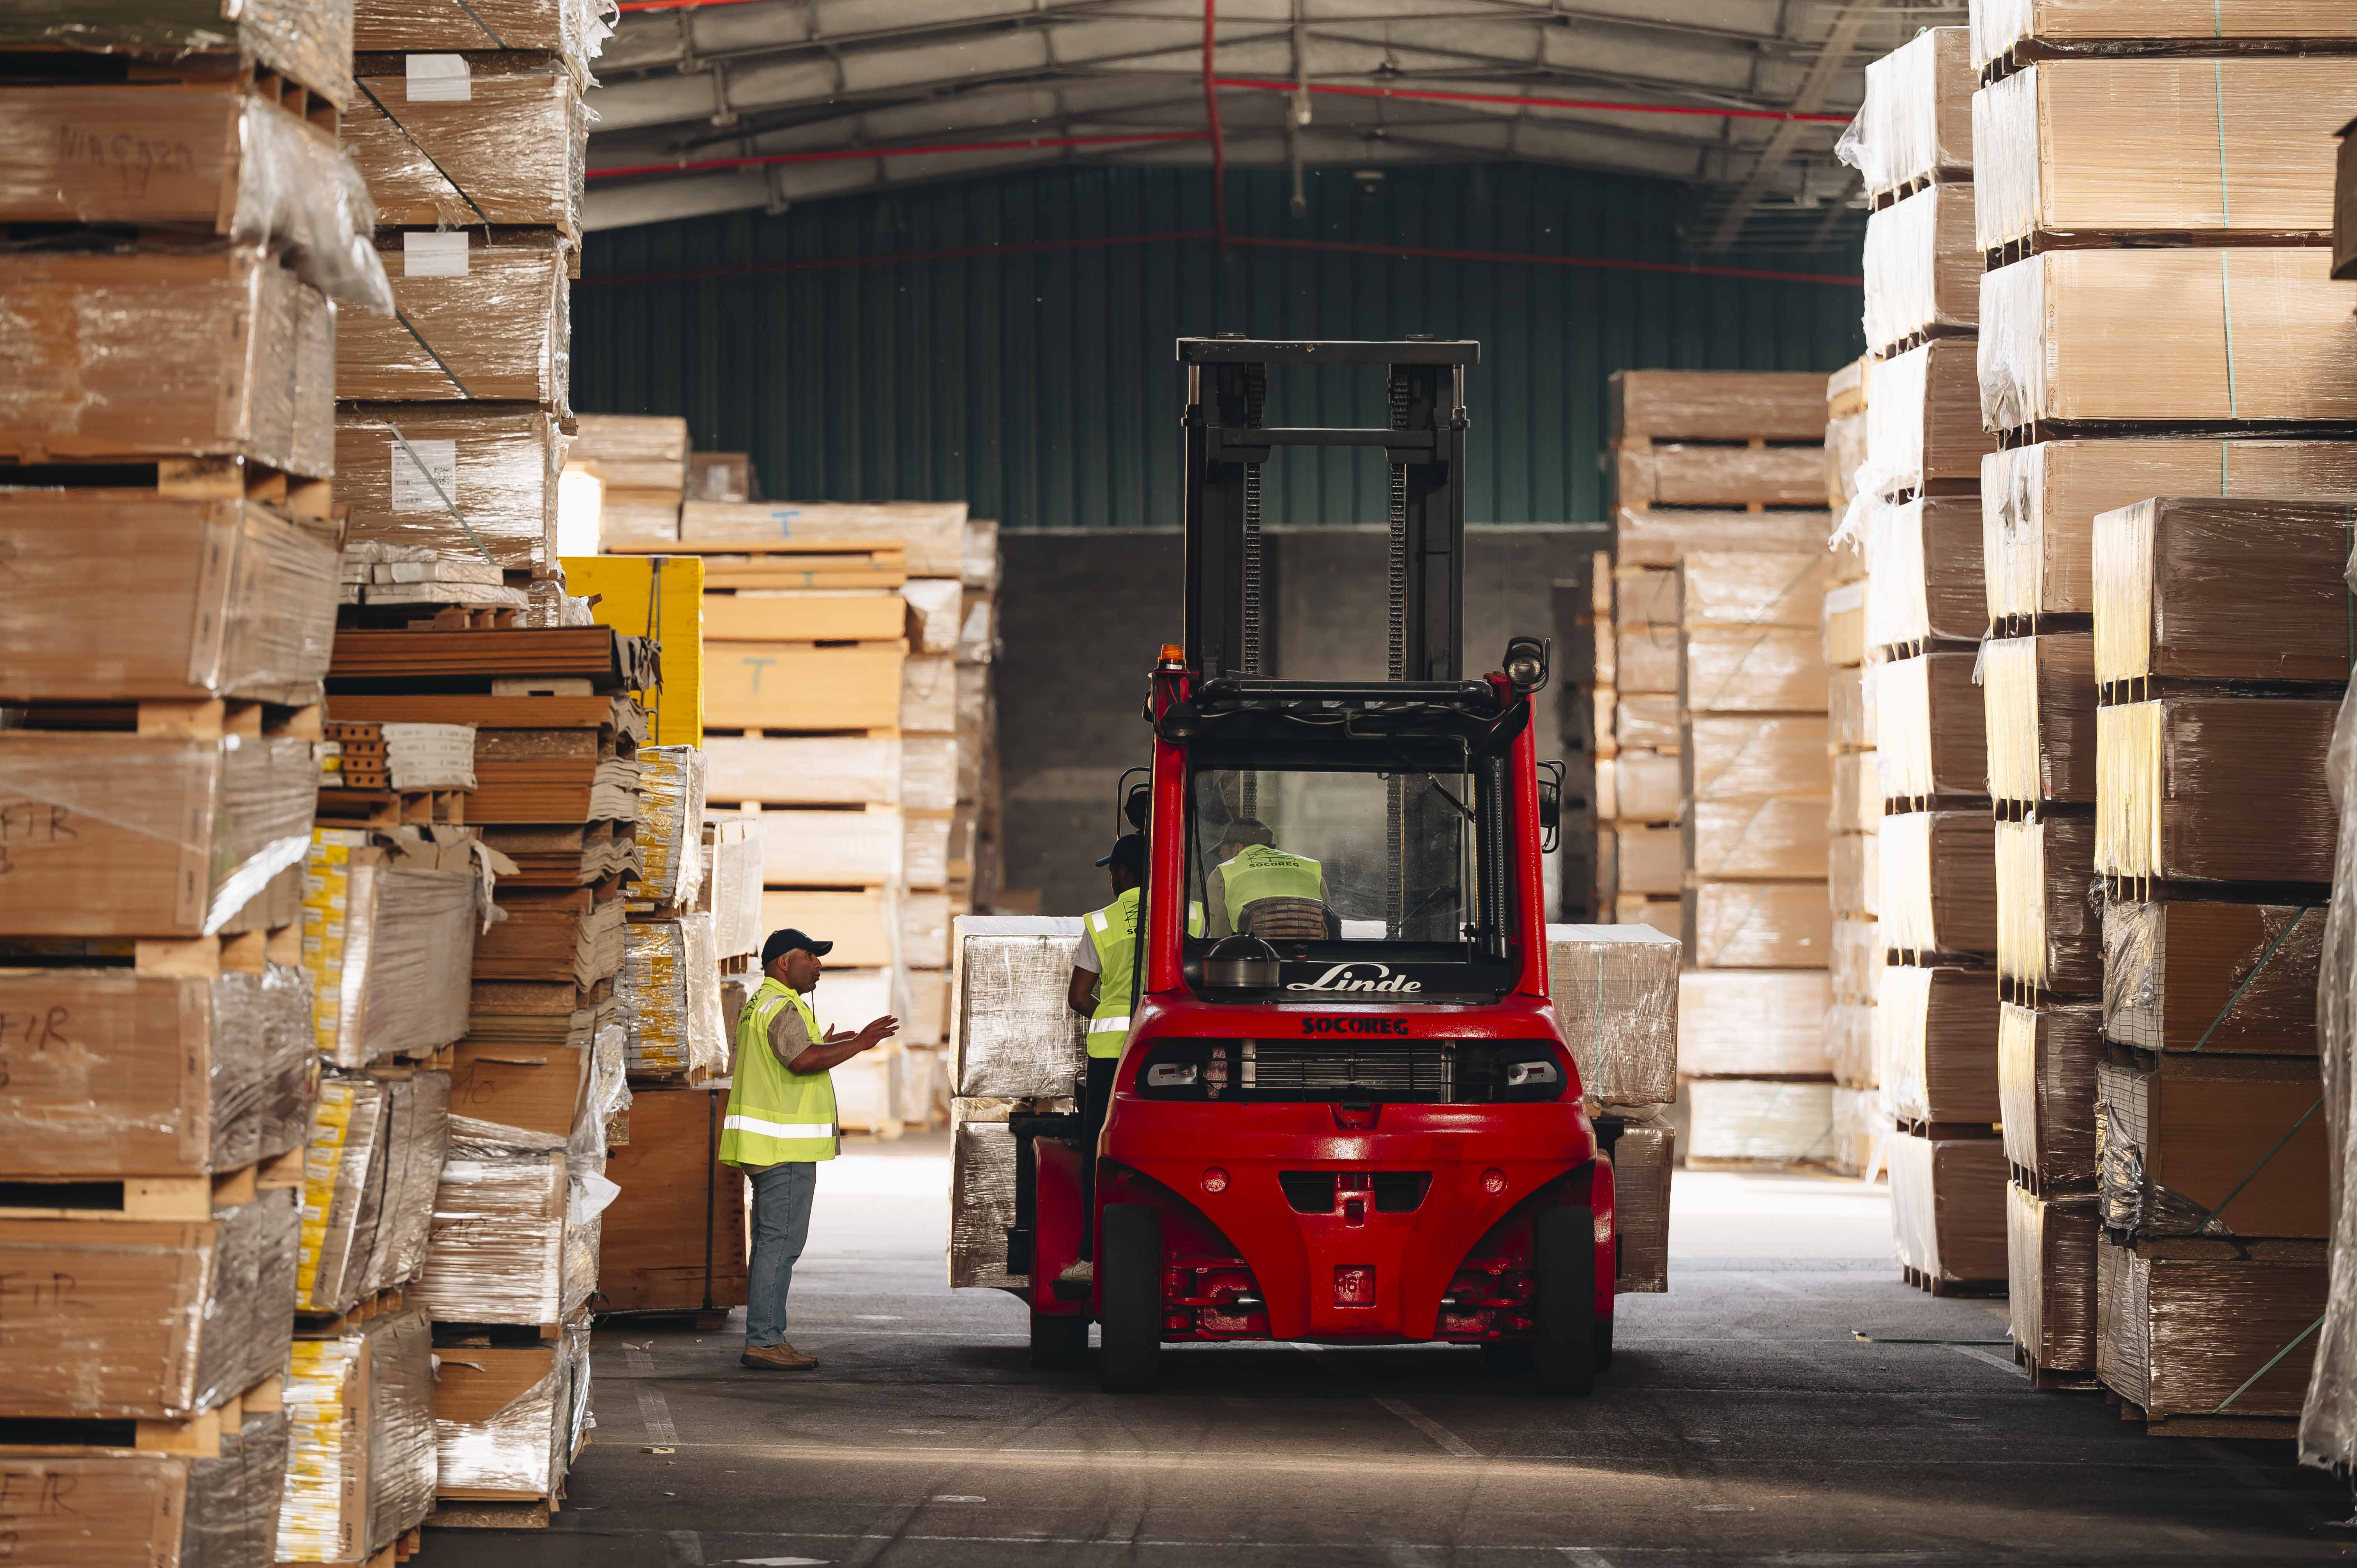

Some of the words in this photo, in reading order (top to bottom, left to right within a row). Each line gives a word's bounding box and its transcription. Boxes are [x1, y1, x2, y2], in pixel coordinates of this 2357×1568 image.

[772, 511, 800, 539] T
[744, 658, 776, 694] T
[1287, 963, 1421, 992] Linde
[1302, 1017, 1409, 1035] SOCOREG
